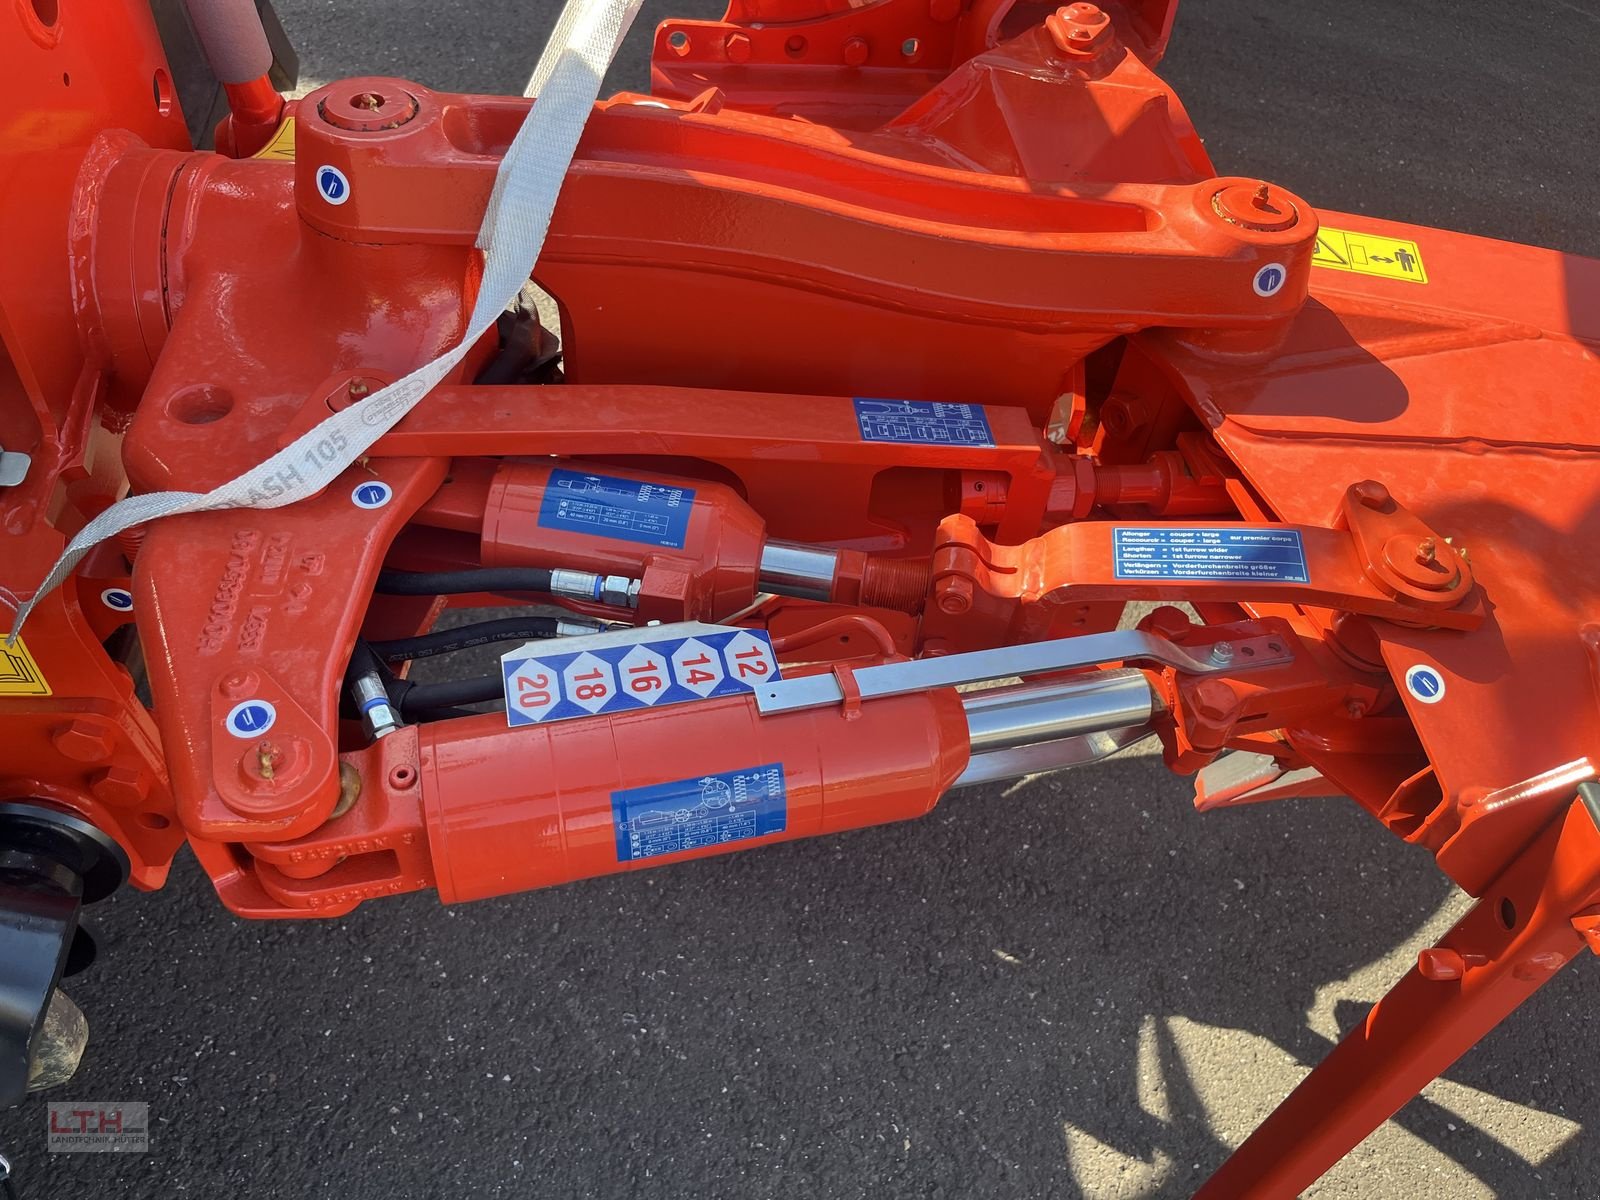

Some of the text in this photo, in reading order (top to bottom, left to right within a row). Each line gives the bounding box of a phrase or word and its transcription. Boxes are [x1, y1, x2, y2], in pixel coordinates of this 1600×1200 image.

[304, 428, 348, 471] 105
[628, 660, 662, 693] 16
[682, 653, 715, 686] 14
[735, 645, 768, 678] 12
[517, 673, 549, 708] 20
[573, 667, 607, 700] 18
